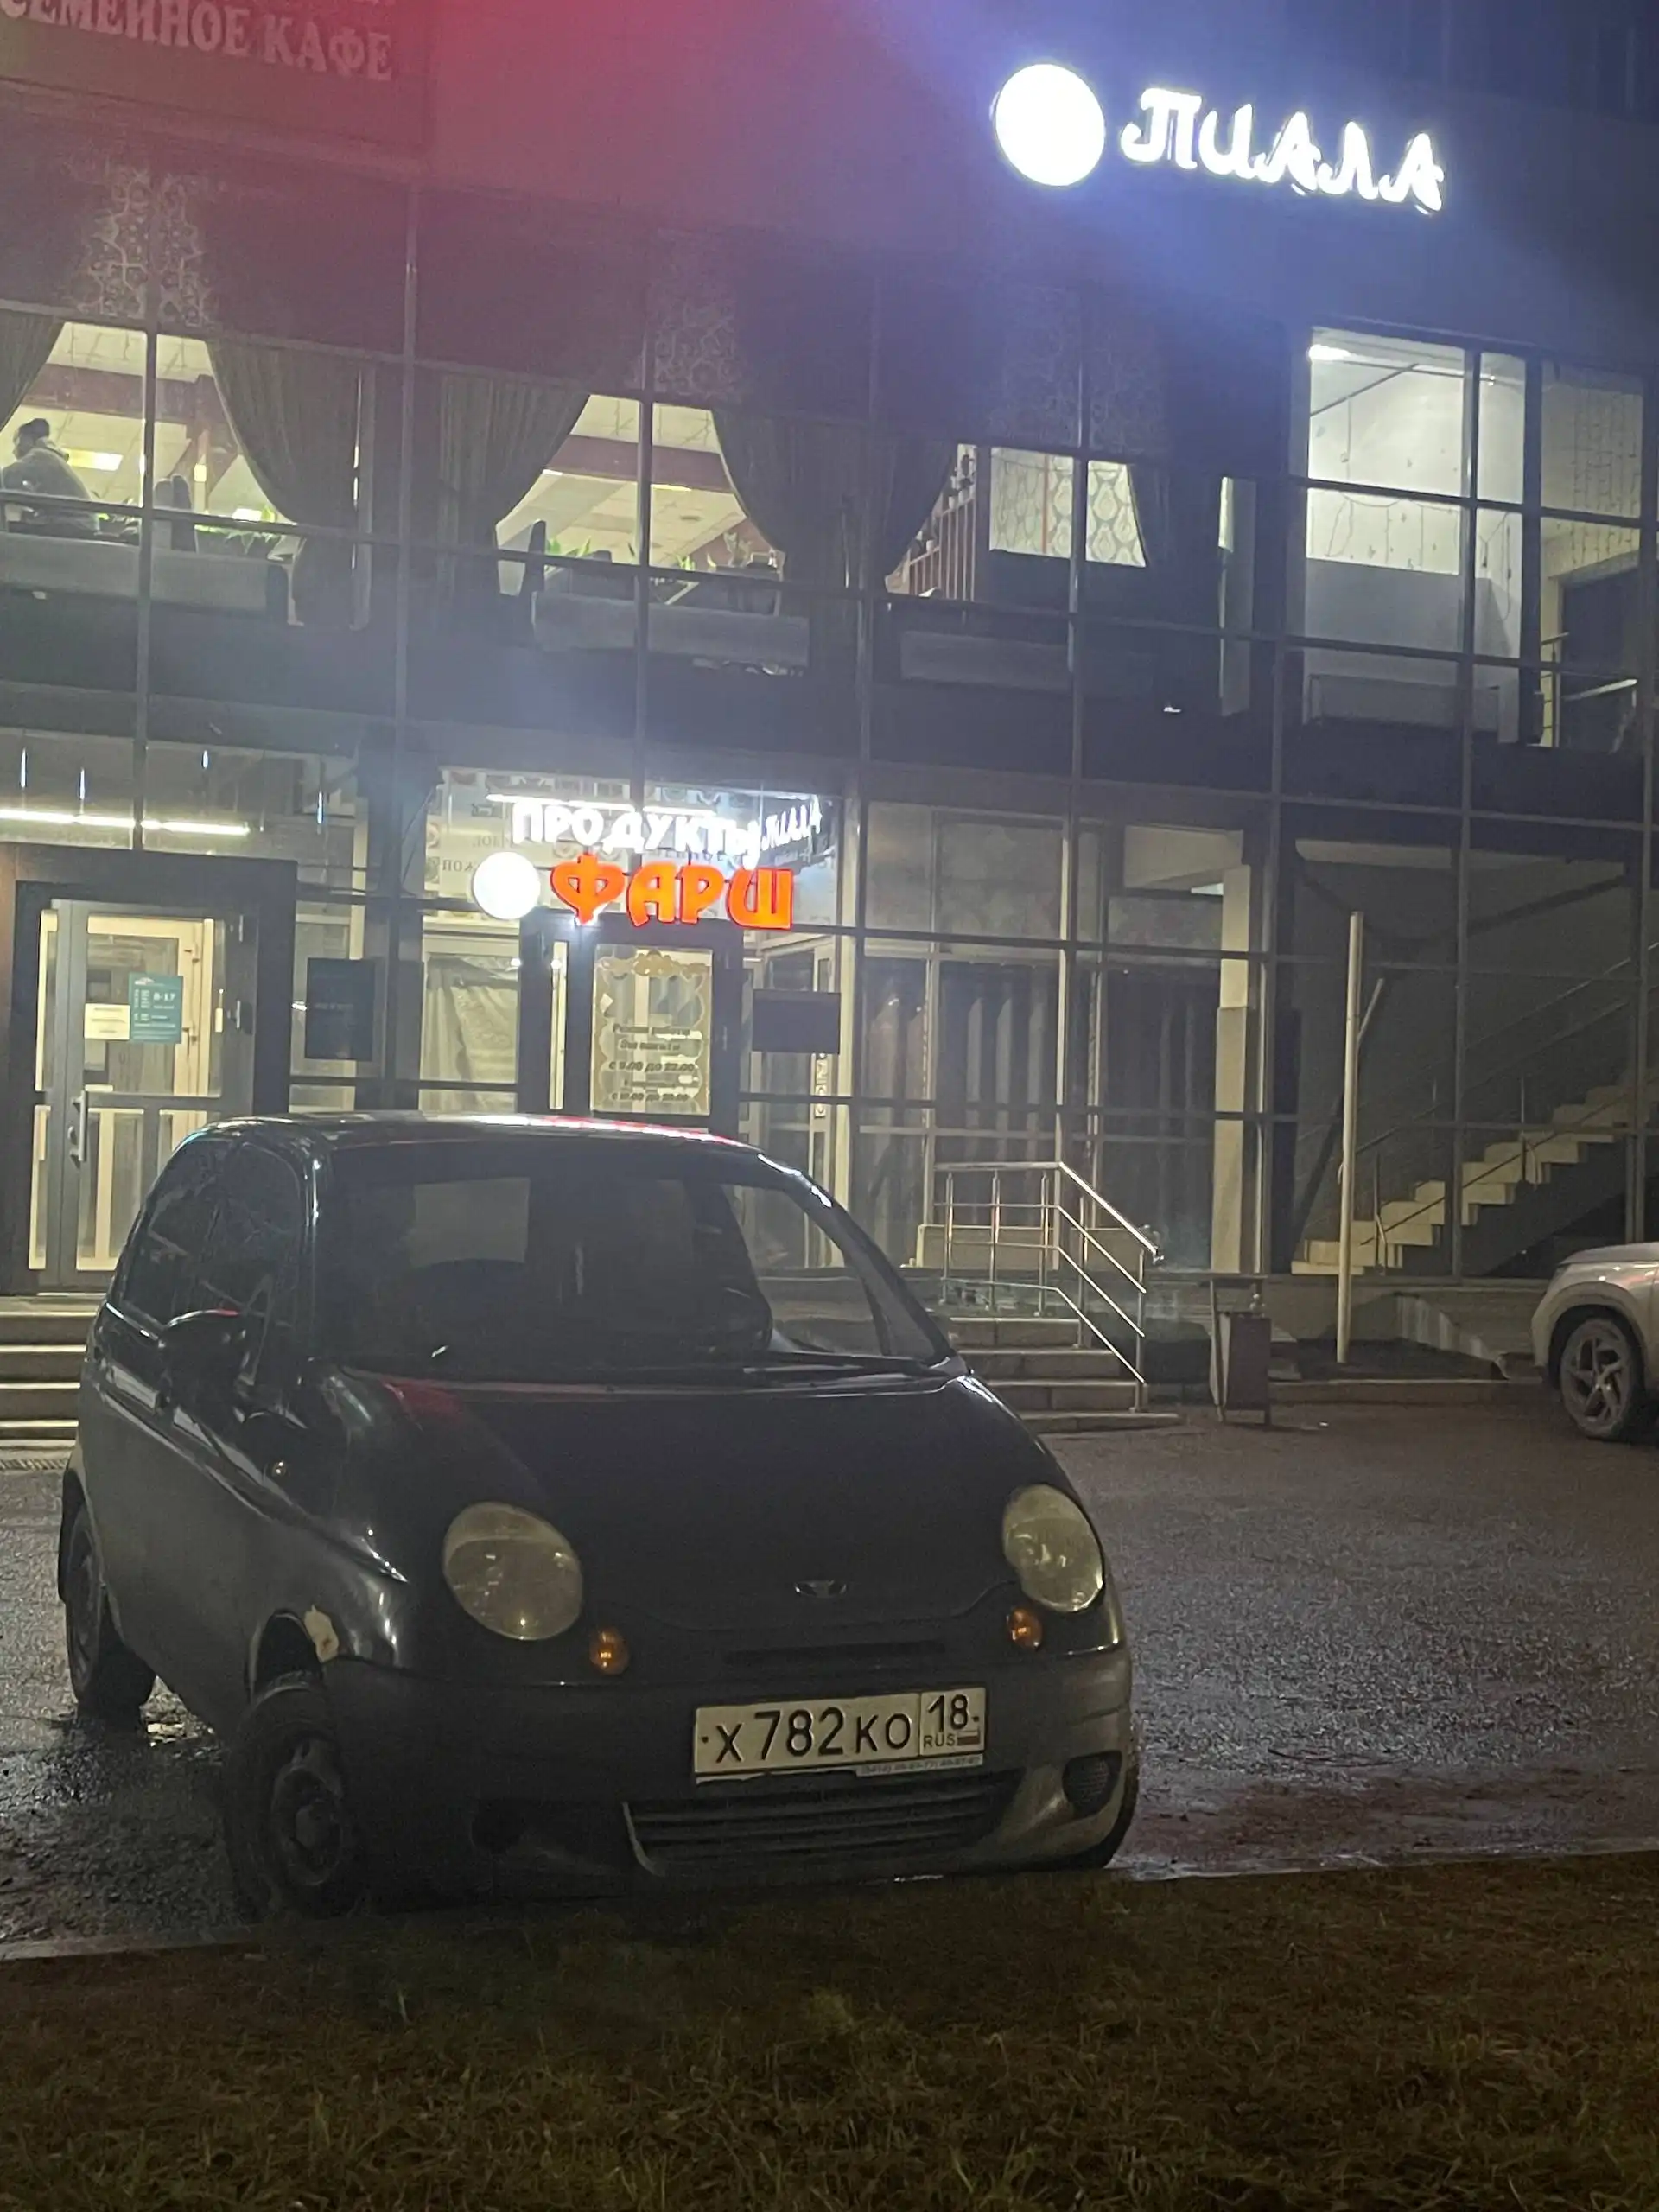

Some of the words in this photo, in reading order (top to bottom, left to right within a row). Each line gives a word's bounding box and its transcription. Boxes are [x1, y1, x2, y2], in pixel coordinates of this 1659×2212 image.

[264, 14, 394, 81] КАФЕ
[1120, 87, 1445, 213] ПИАЛА
[550, 853, 793, 930] ФАРШ
[923, 1732, 957, 1749] RUS
[927, 1694, 969, 1732] 18
